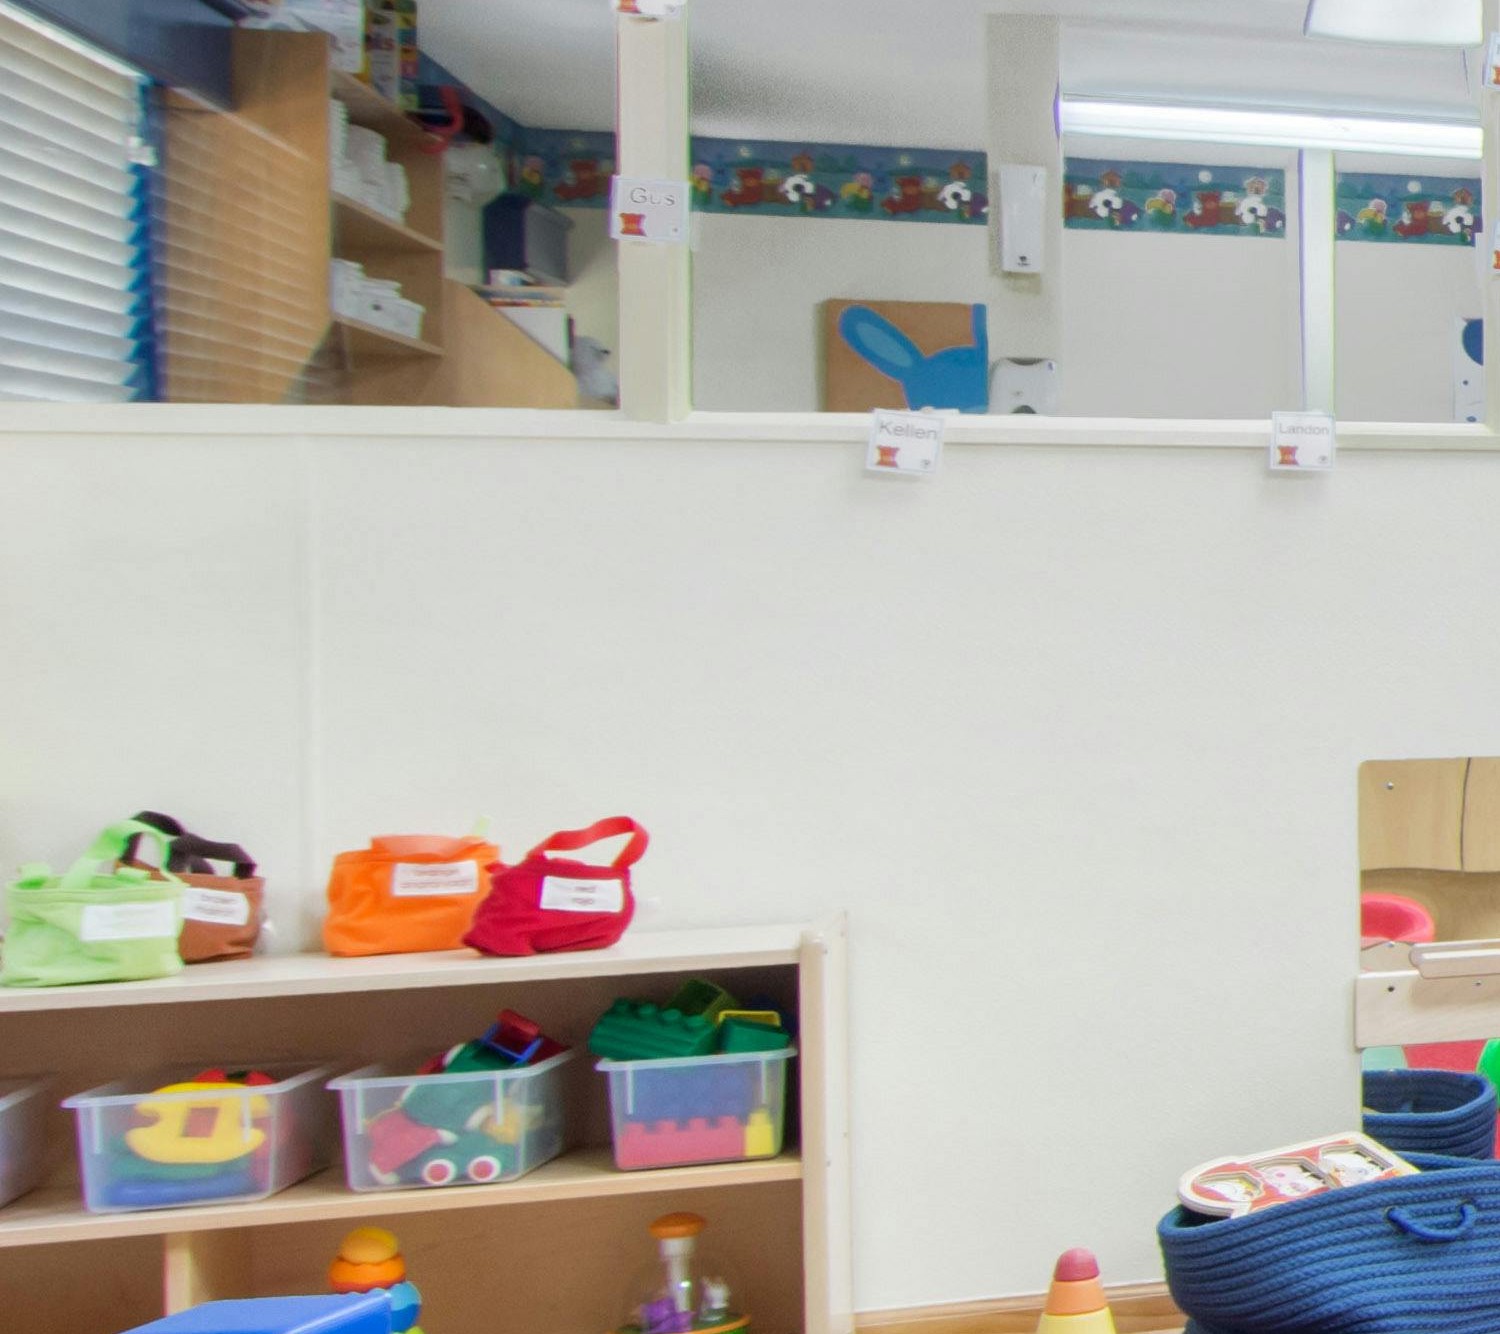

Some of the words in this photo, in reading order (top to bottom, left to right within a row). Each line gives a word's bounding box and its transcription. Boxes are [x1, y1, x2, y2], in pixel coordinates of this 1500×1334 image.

[630, 187, 676, 207] Gus
[879, 420, 938, 440] Kellen
[1279, 423, 1329, 436] Landon
